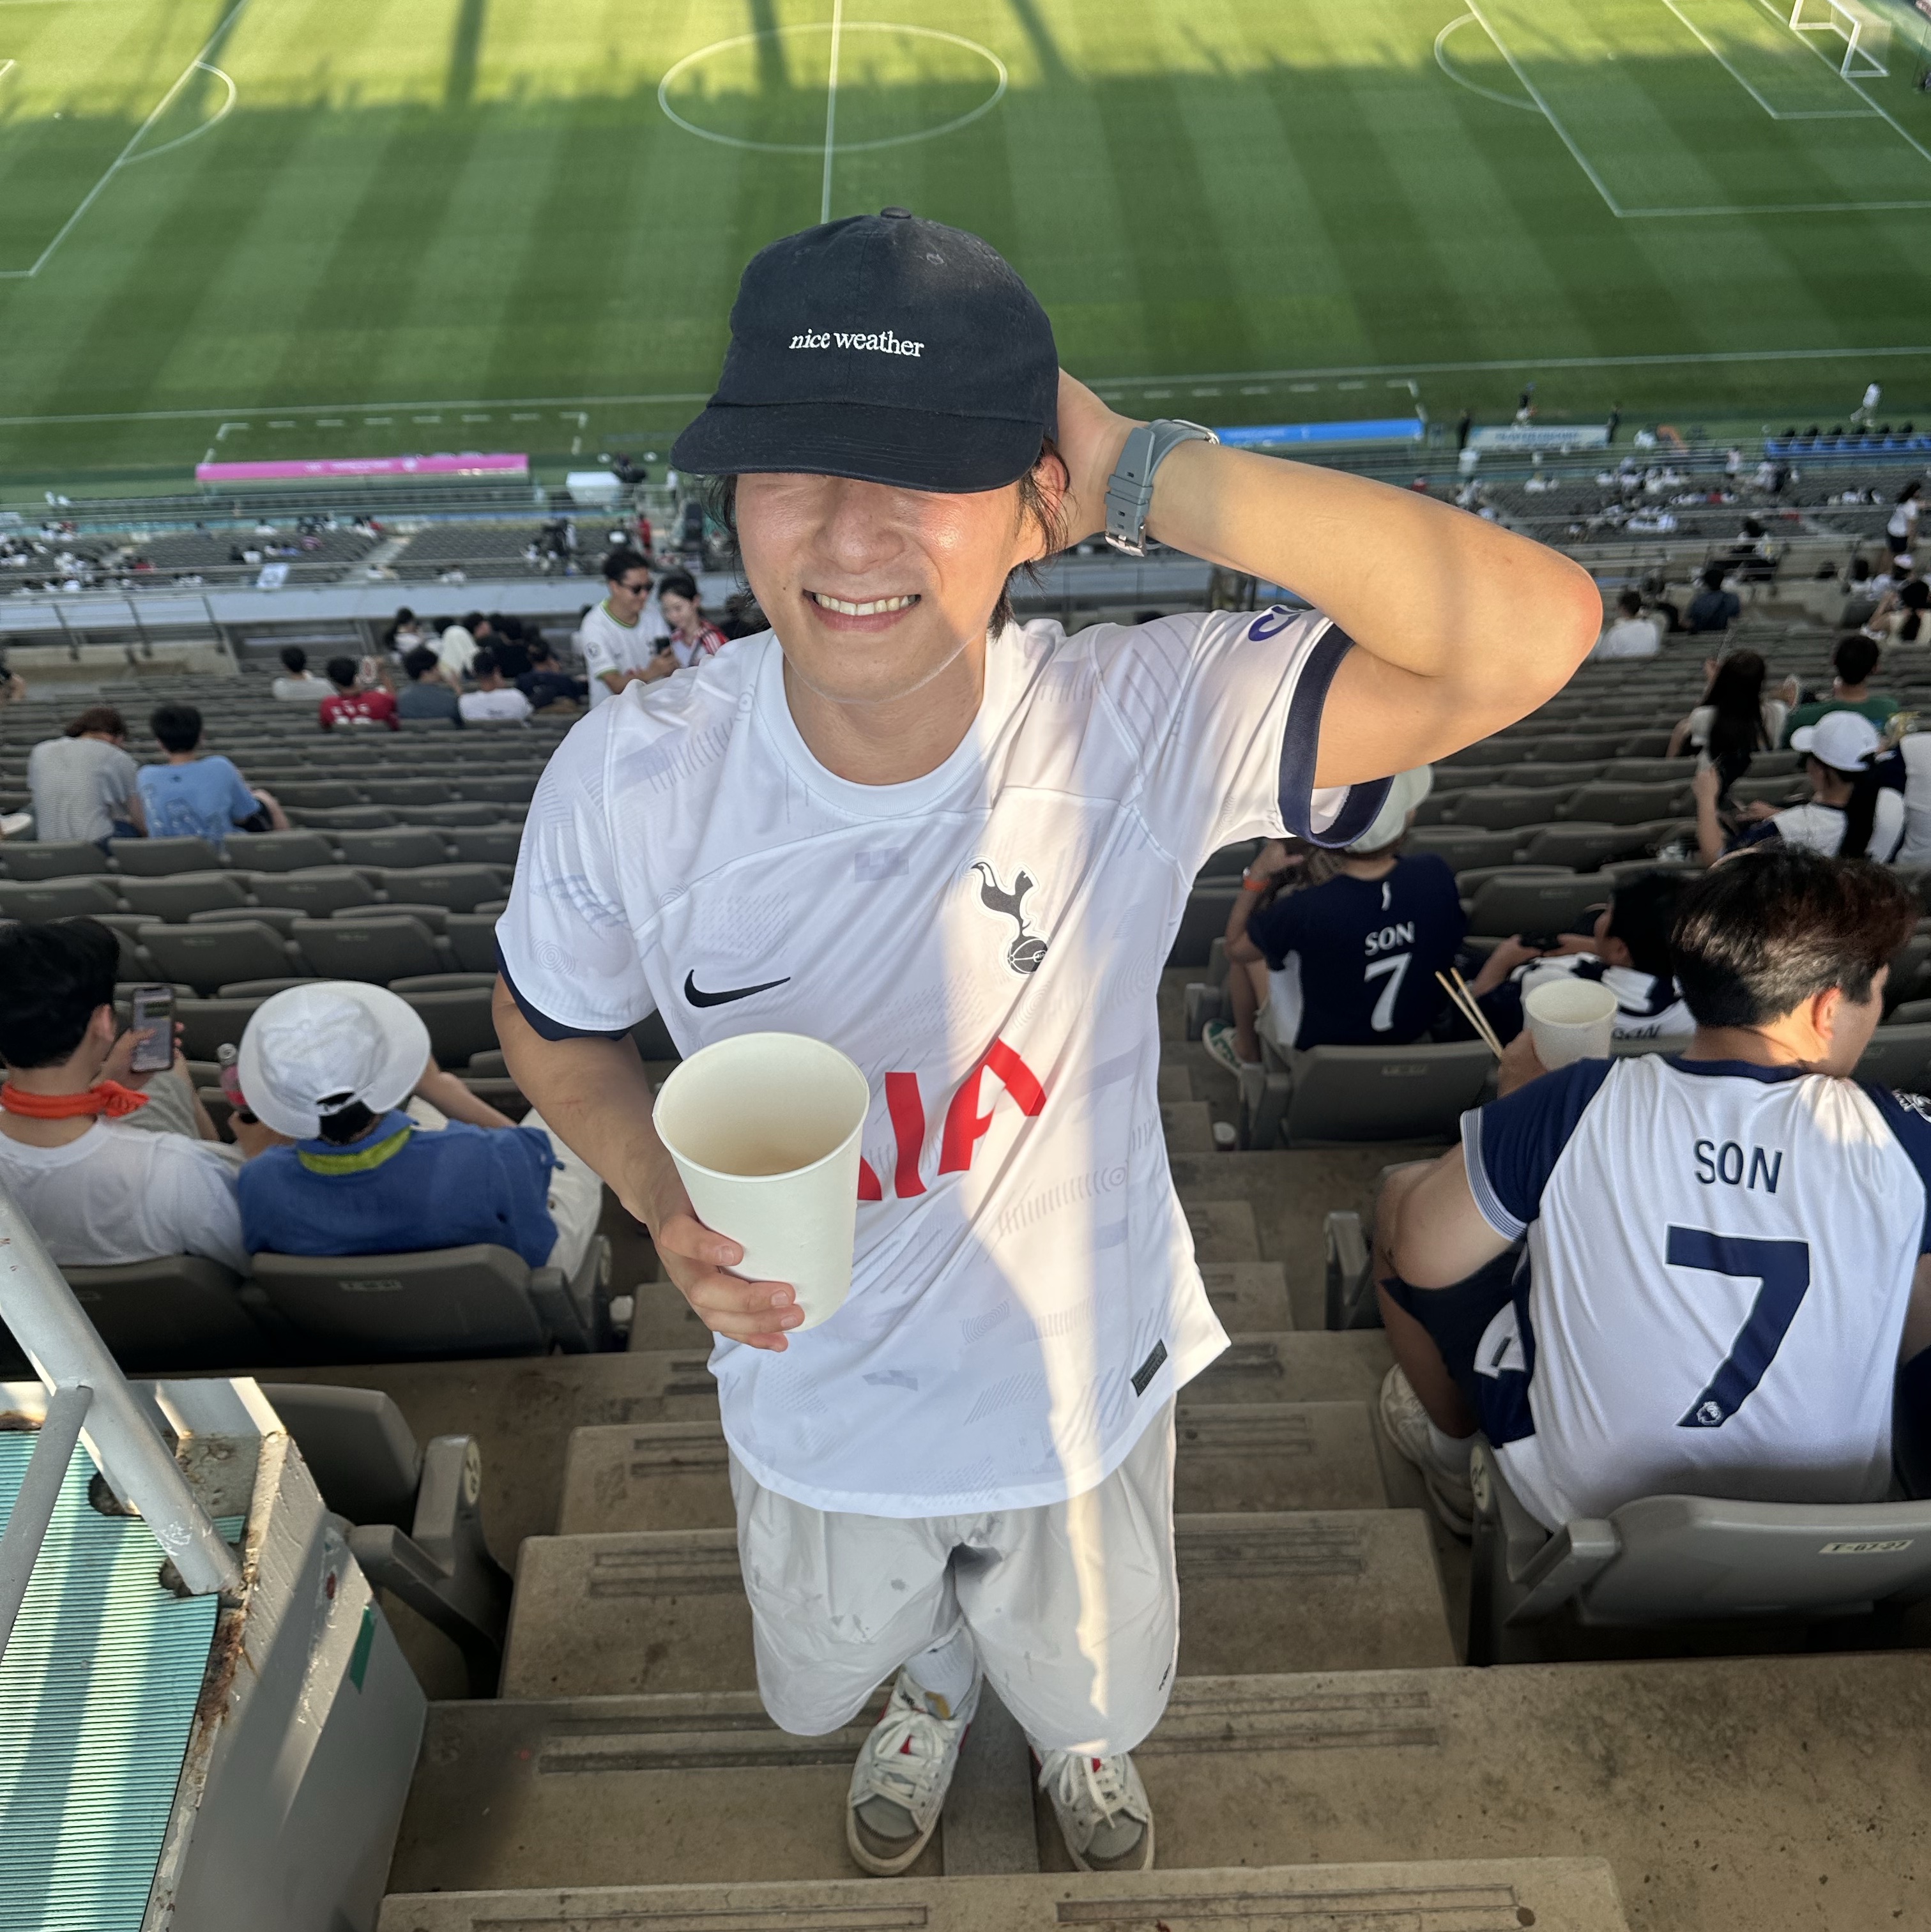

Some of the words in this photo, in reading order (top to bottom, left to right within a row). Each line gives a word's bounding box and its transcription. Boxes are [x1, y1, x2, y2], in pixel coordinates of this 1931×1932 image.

[788, 328, 831, 349] nice
[834, 330, 925, 357] weather
[1364, 920, 1416, 957] SON
[1364, 952, 1412, 1032] 7
[857, 1035, 1048, 1201] IA
[1693, 1139, 1783, 1194] SON
[1665, 1224, 1811, 1428] 7
